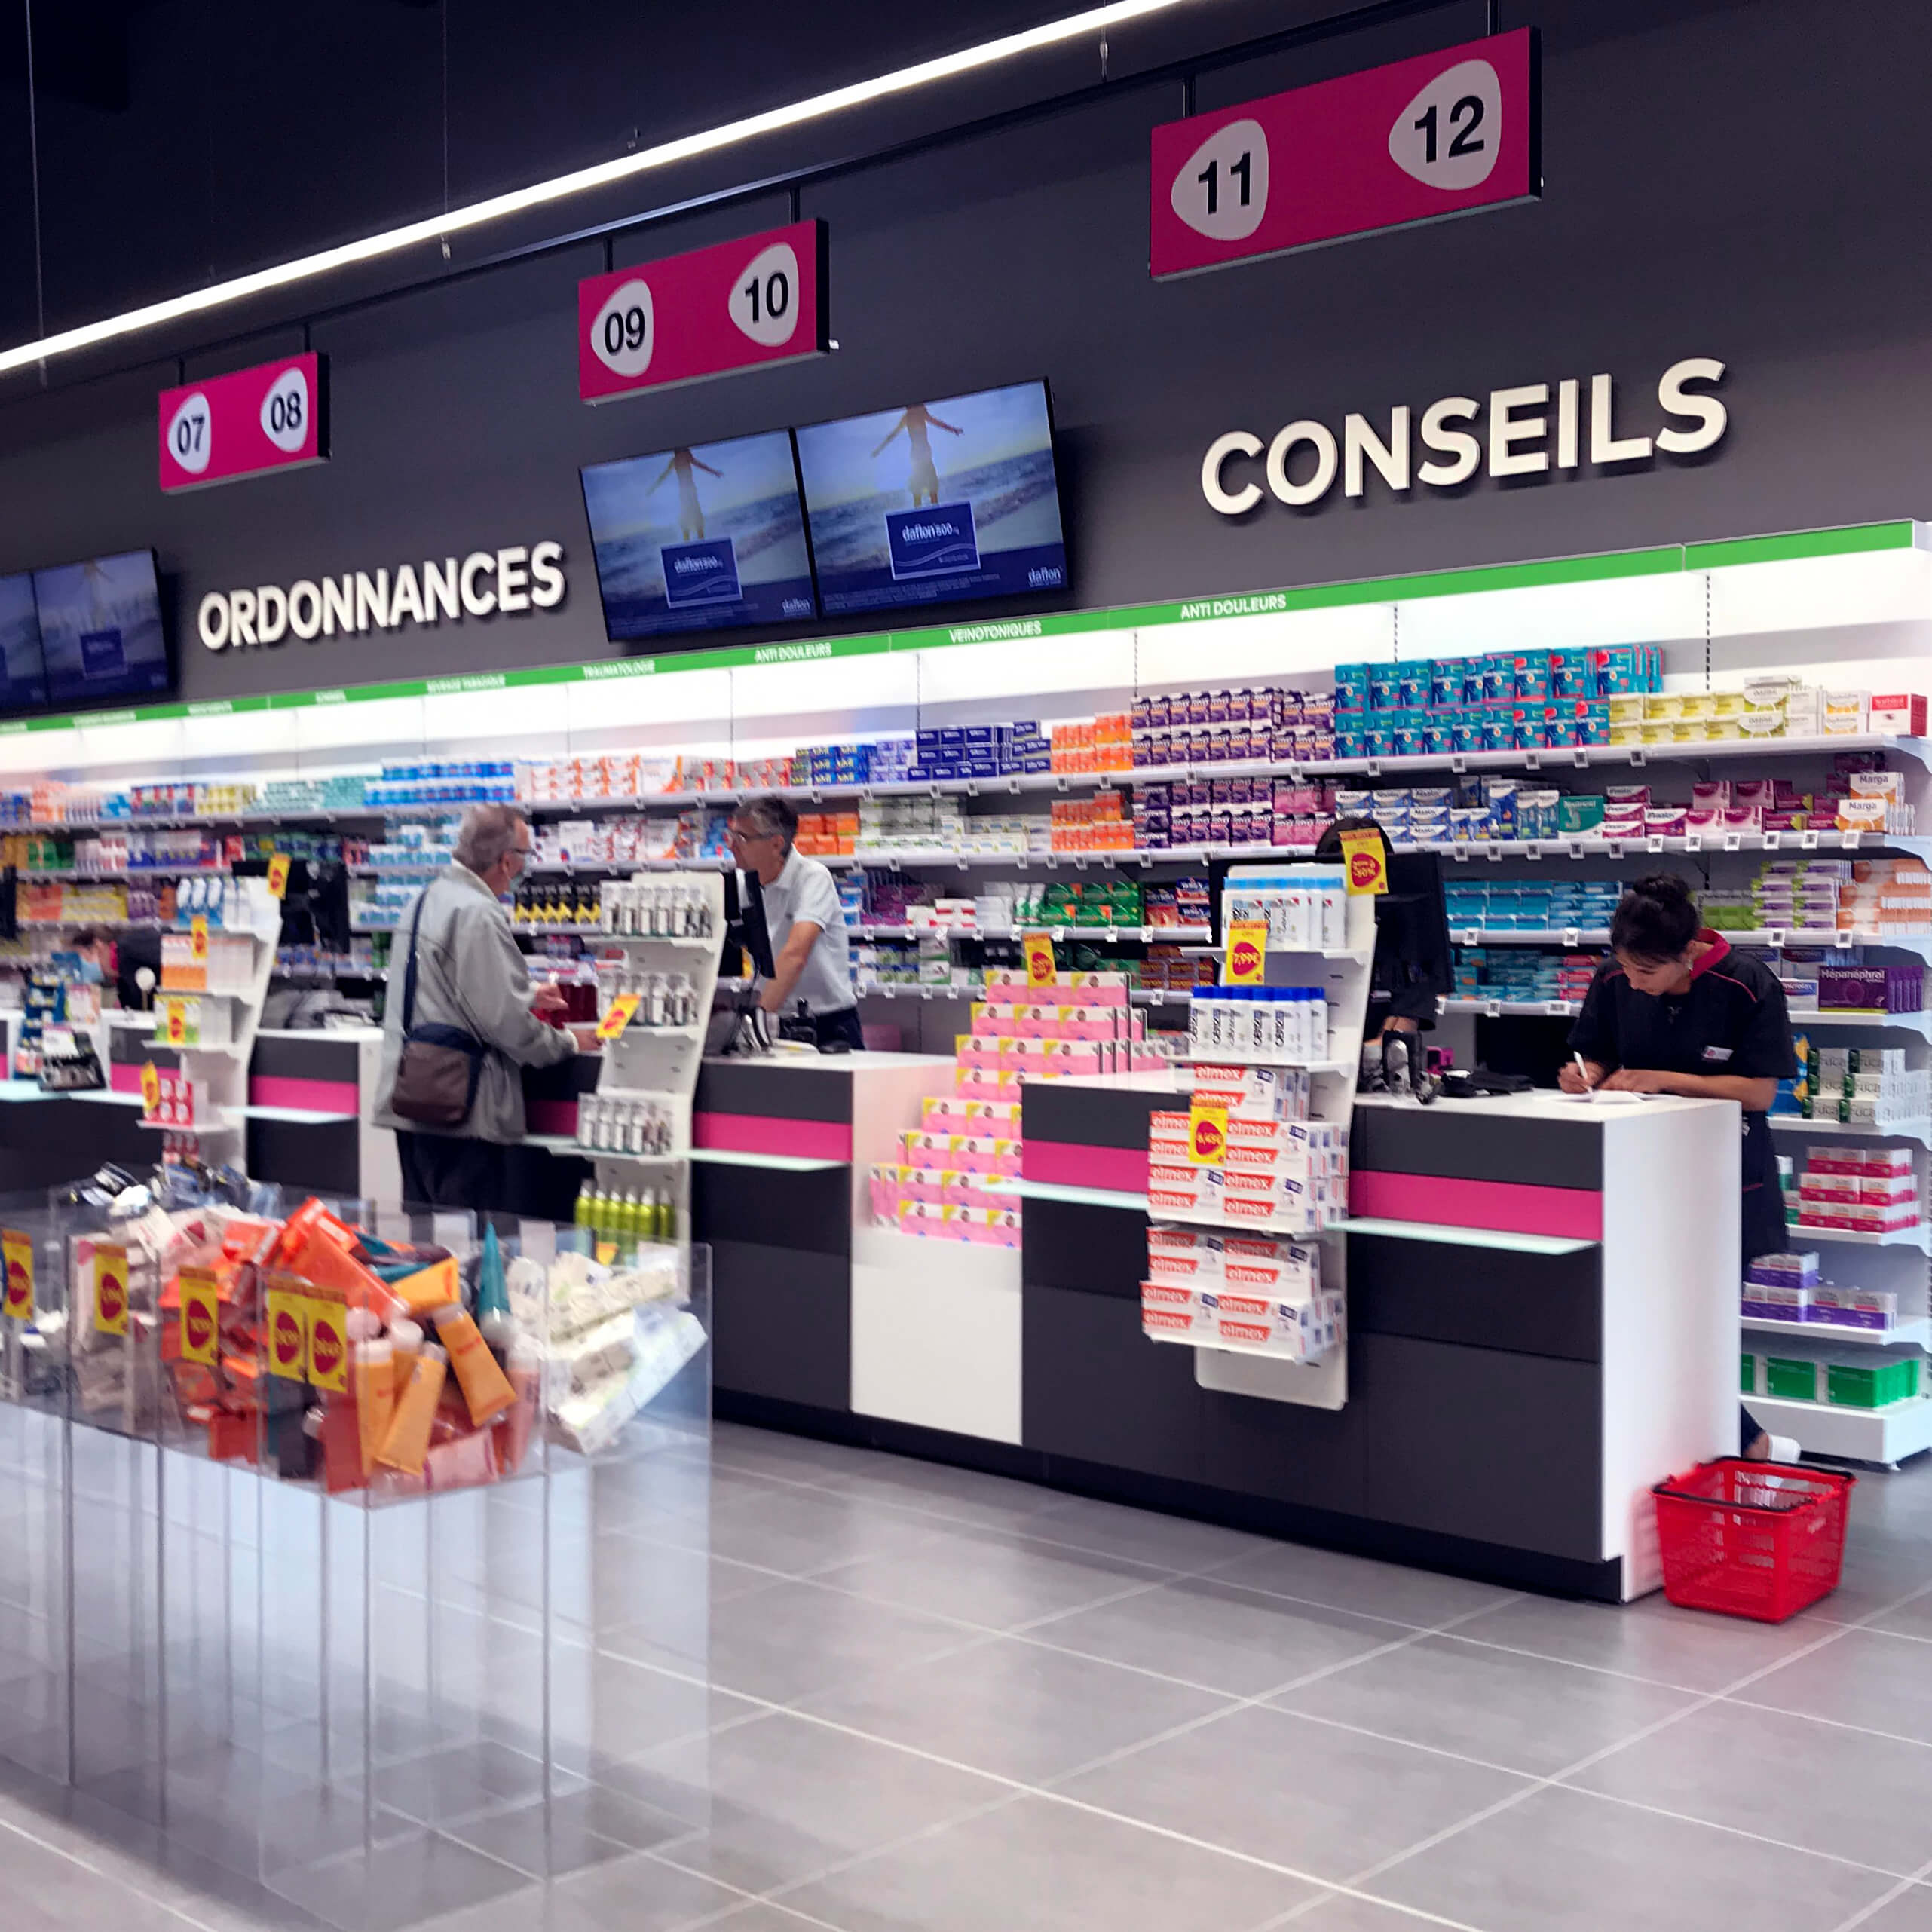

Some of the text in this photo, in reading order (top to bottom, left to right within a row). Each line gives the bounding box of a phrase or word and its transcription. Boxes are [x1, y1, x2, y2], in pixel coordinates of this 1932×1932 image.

[1199, 96, 1485, 215] 11 12
[605, 272, 789, 355] 09 10
[177, 391, 302, 455] 07 08
[1202, 359, 1727, 515] CONSEILS
[198, 541, 564, 650] ORDONNANCES
[1180, 593, 1287, 620] ANTI DOULEURS
[948, 620, 1042, 644] VEINOTONIQUES
[755, 648, 777, 663] ANTI
[1848, 801, 1877, 812] Marga
[1196, 1066, 1241, 1081] elmex
[1229, 1122, 1272, 1137] elmex
[1228, 1148, 1272, 1164] elmex
[1152, 1168, 1193, 1183] elmex
[1226, 1174, 1269, 1190] elmex
[1150, 1193, 1191, 1208] elmex
[1225, 1202, 1269, 1217] elmex
[1151, 1232, 1192, 1248] elmex
[1151, 1258, 1195, 1275] elmex
[1229, 1269, 1272, 1284] elmex
[1144, 1287, 1186, 1303] elmex
[1219, 1299, 1263, 1315] elmex
[1144, 1312, 1186, 1330] elmex
[1220, 1324, 1266, 1342] elmex
